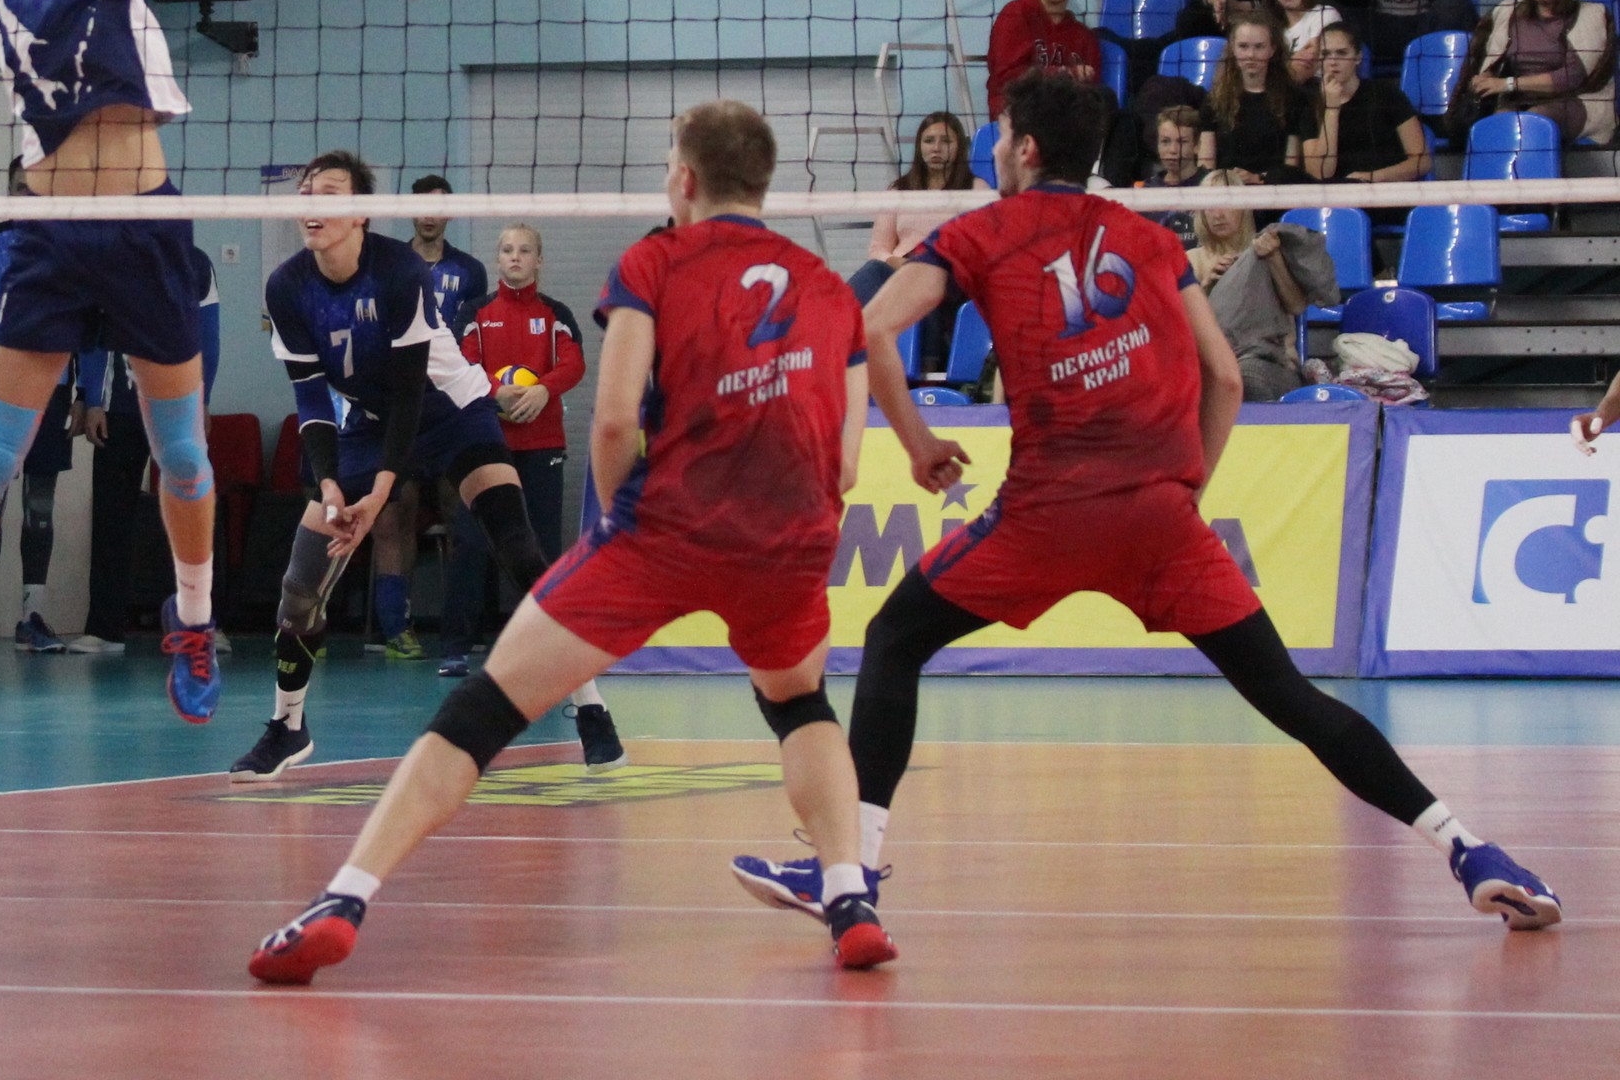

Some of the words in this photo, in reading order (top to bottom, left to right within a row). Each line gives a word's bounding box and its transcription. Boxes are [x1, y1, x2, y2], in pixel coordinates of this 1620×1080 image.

[740, 263, 796, 349] 2
[1043, 225, 1136, 339] 16
[330, 328, 354, 378] 7
[1049, 323, 1151, 382] ПЕРМСКИЙ
[1082, 353, 1130, 391] КРАЙ
